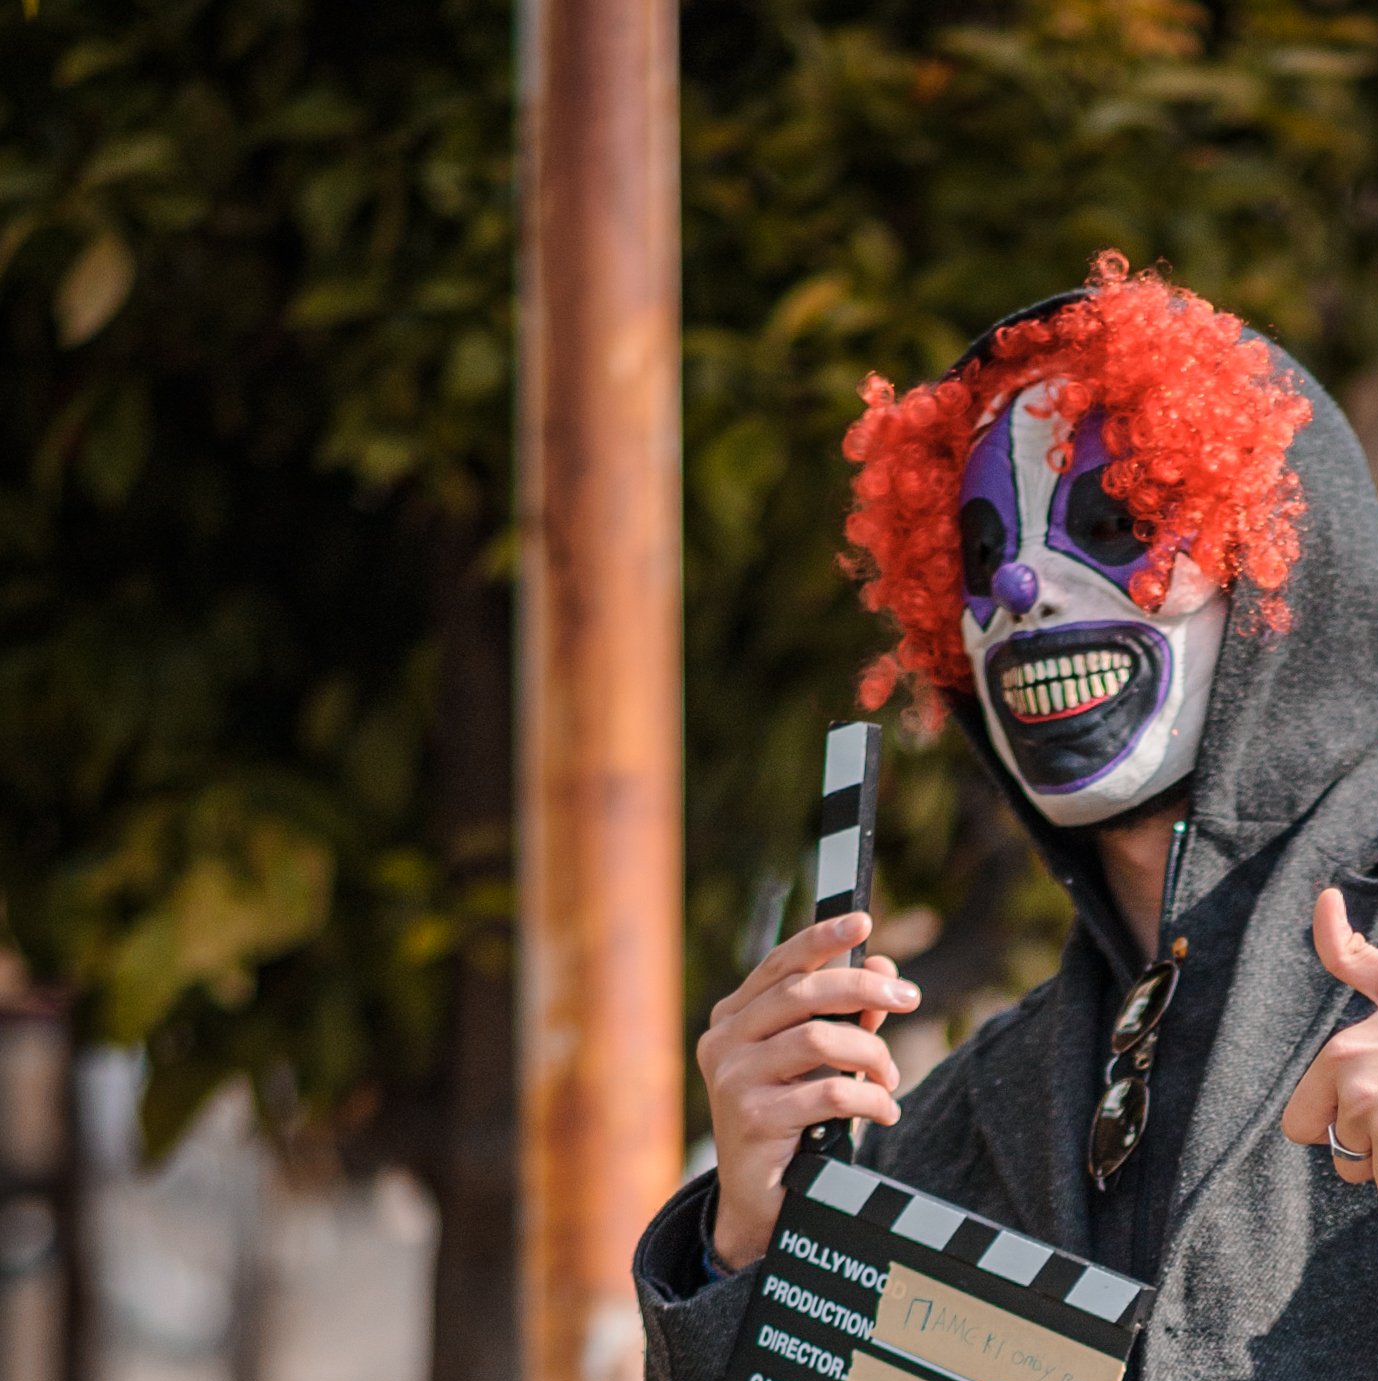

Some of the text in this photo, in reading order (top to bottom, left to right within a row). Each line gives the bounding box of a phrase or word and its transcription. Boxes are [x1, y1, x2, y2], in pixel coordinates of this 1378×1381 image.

[779, 1229, 907, 1301] HOLLYWOOD
[762, 1275, 874, 1341] PRODUCTION
[757, 1324, 845, 1381] DIRECTOR
